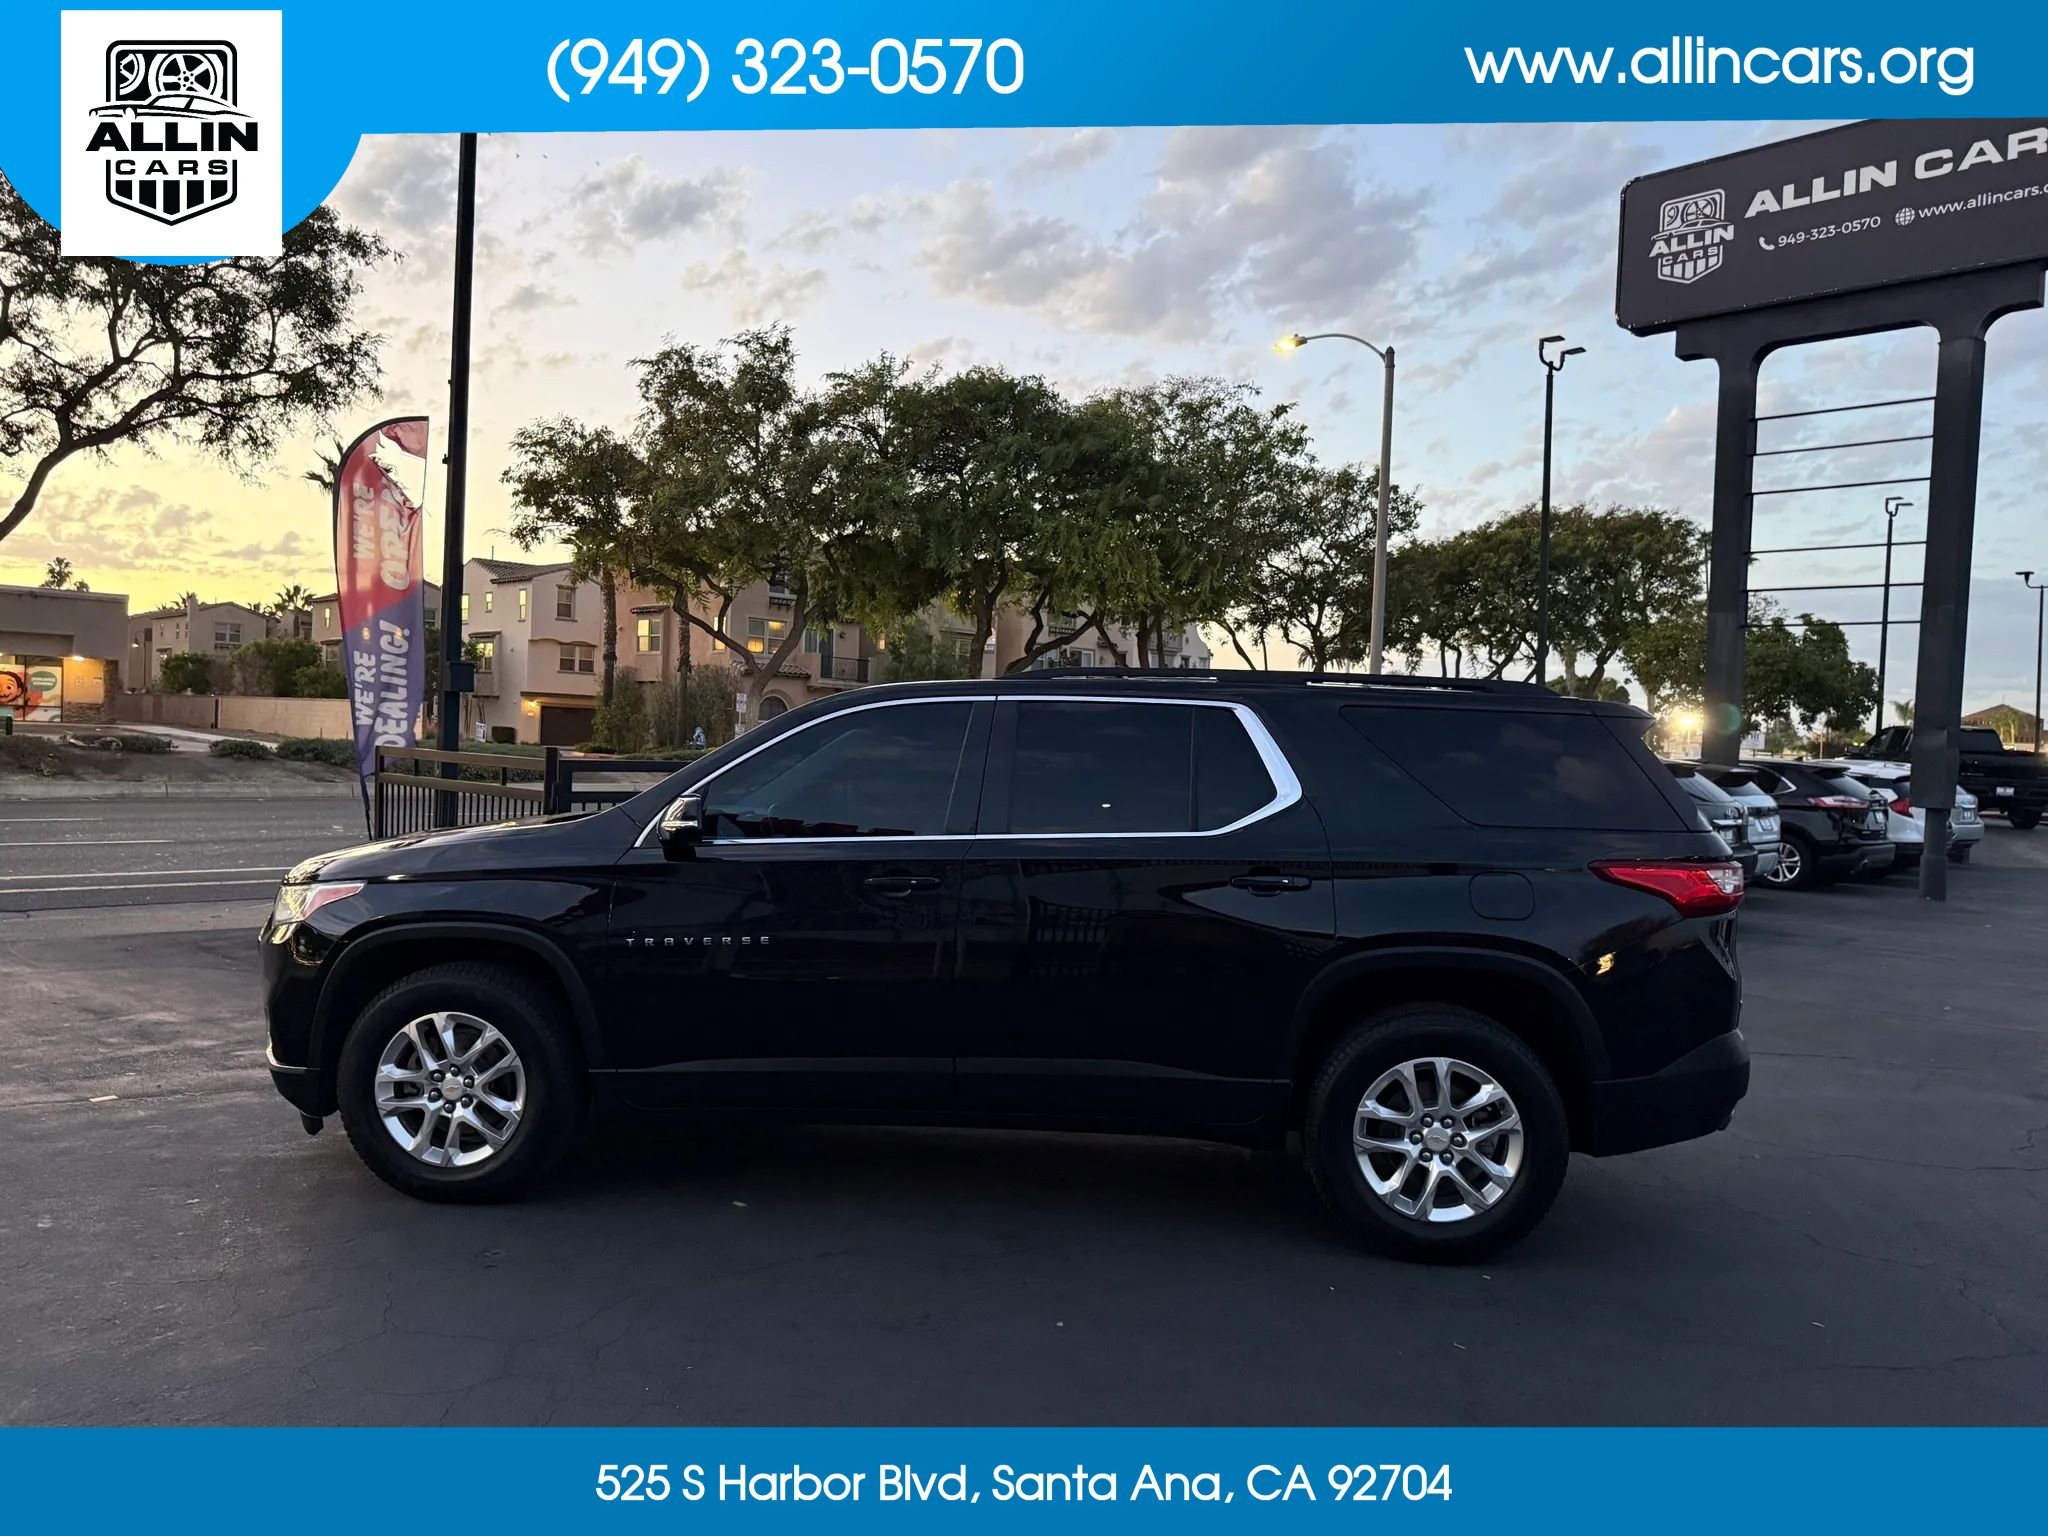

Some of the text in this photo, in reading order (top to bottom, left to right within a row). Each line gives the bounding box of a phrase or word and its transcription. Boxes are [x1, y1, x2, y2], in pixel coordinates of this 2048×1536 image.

[1744, 160, 1897, 218] ALLIN
[1648, 225, 1735, 257] ALLIN
[1778, 216, 1881, 247] 949-323-0570
[1662, 246, 1718, 265] CARS
[353, 482, 375, 559] WE'RE
[353, 650, 376, 725] WE'RE
[374, 620, 410, 747] DEALING!
[626, 936, 770, 947] TRAVERSE
